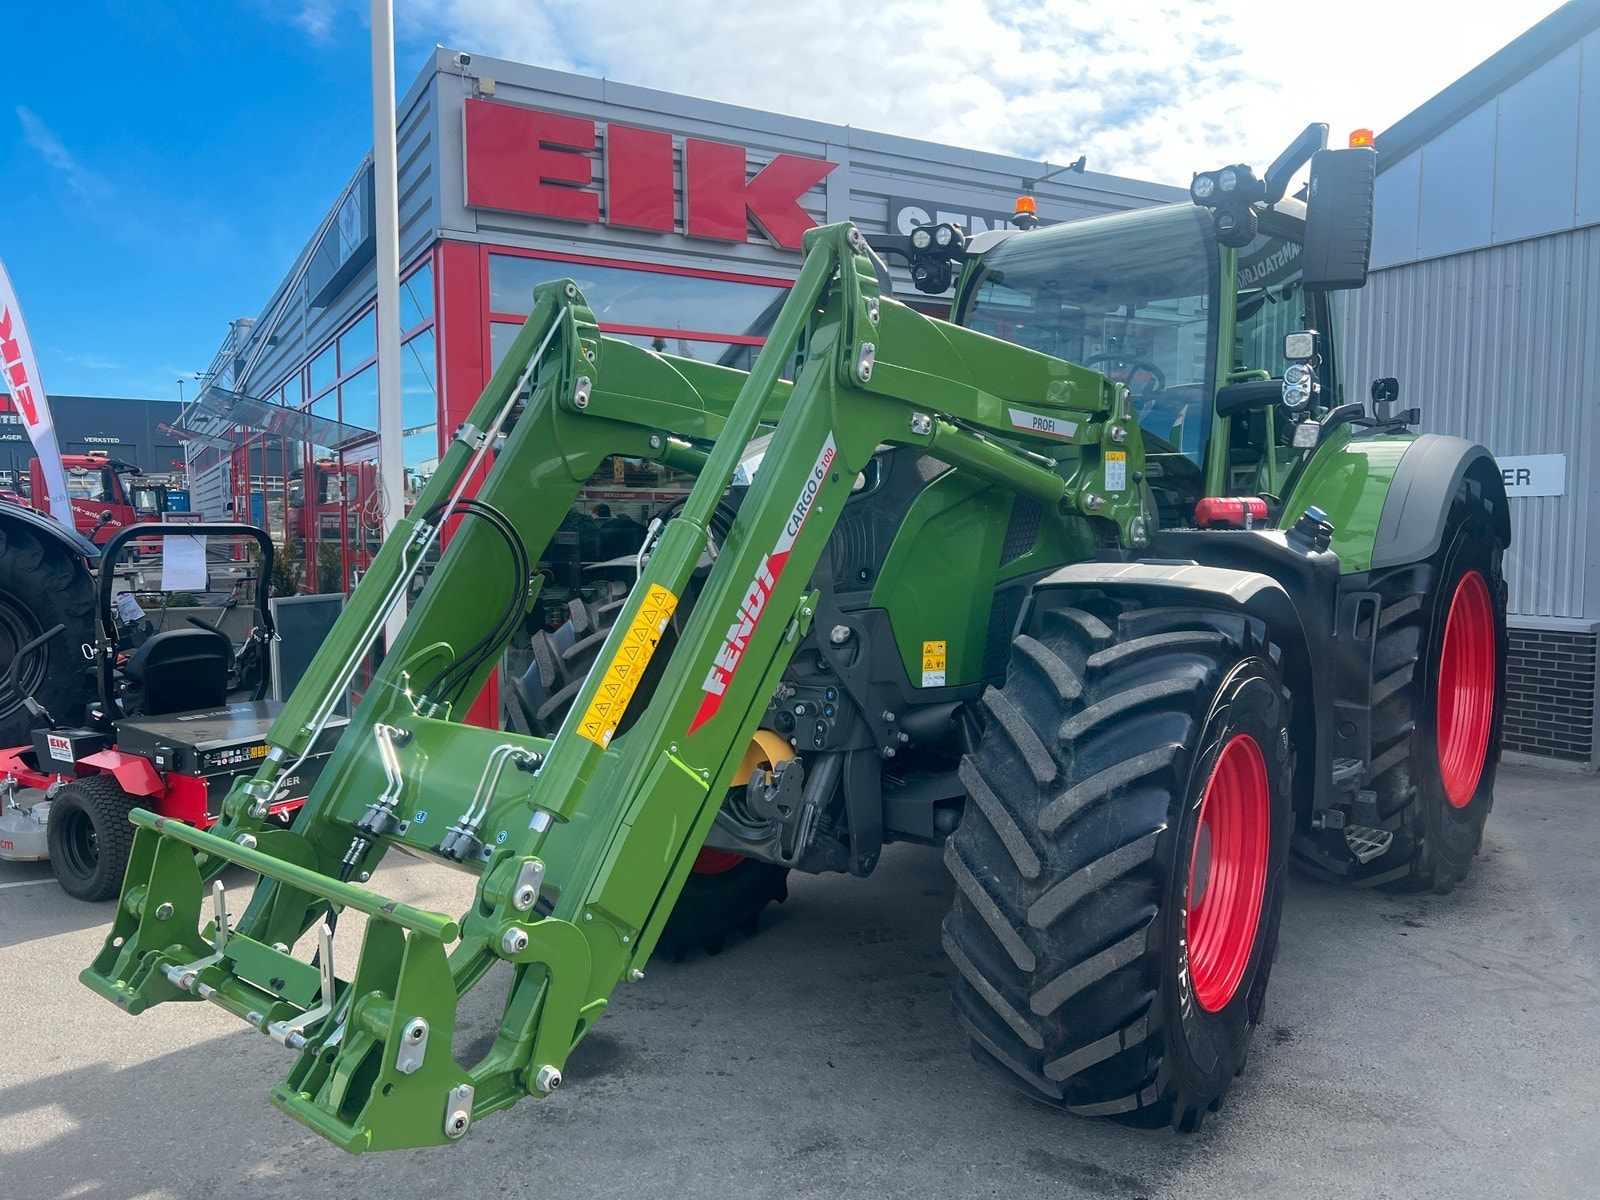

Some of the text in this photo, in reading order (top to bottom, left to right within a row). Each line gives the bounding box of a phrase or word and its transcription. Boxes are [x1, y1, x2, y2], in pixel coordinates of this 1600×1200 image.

[463, 98, 840, 251] EIK
[1033, 417, 1055, 432] PROFI
[787, 447, 834, 538] CARGO 6 100
[1501, 469, 1531, 486] ER
[701, 552, 775, 696] FENDT
[50, 738, 69, 750] EIK
